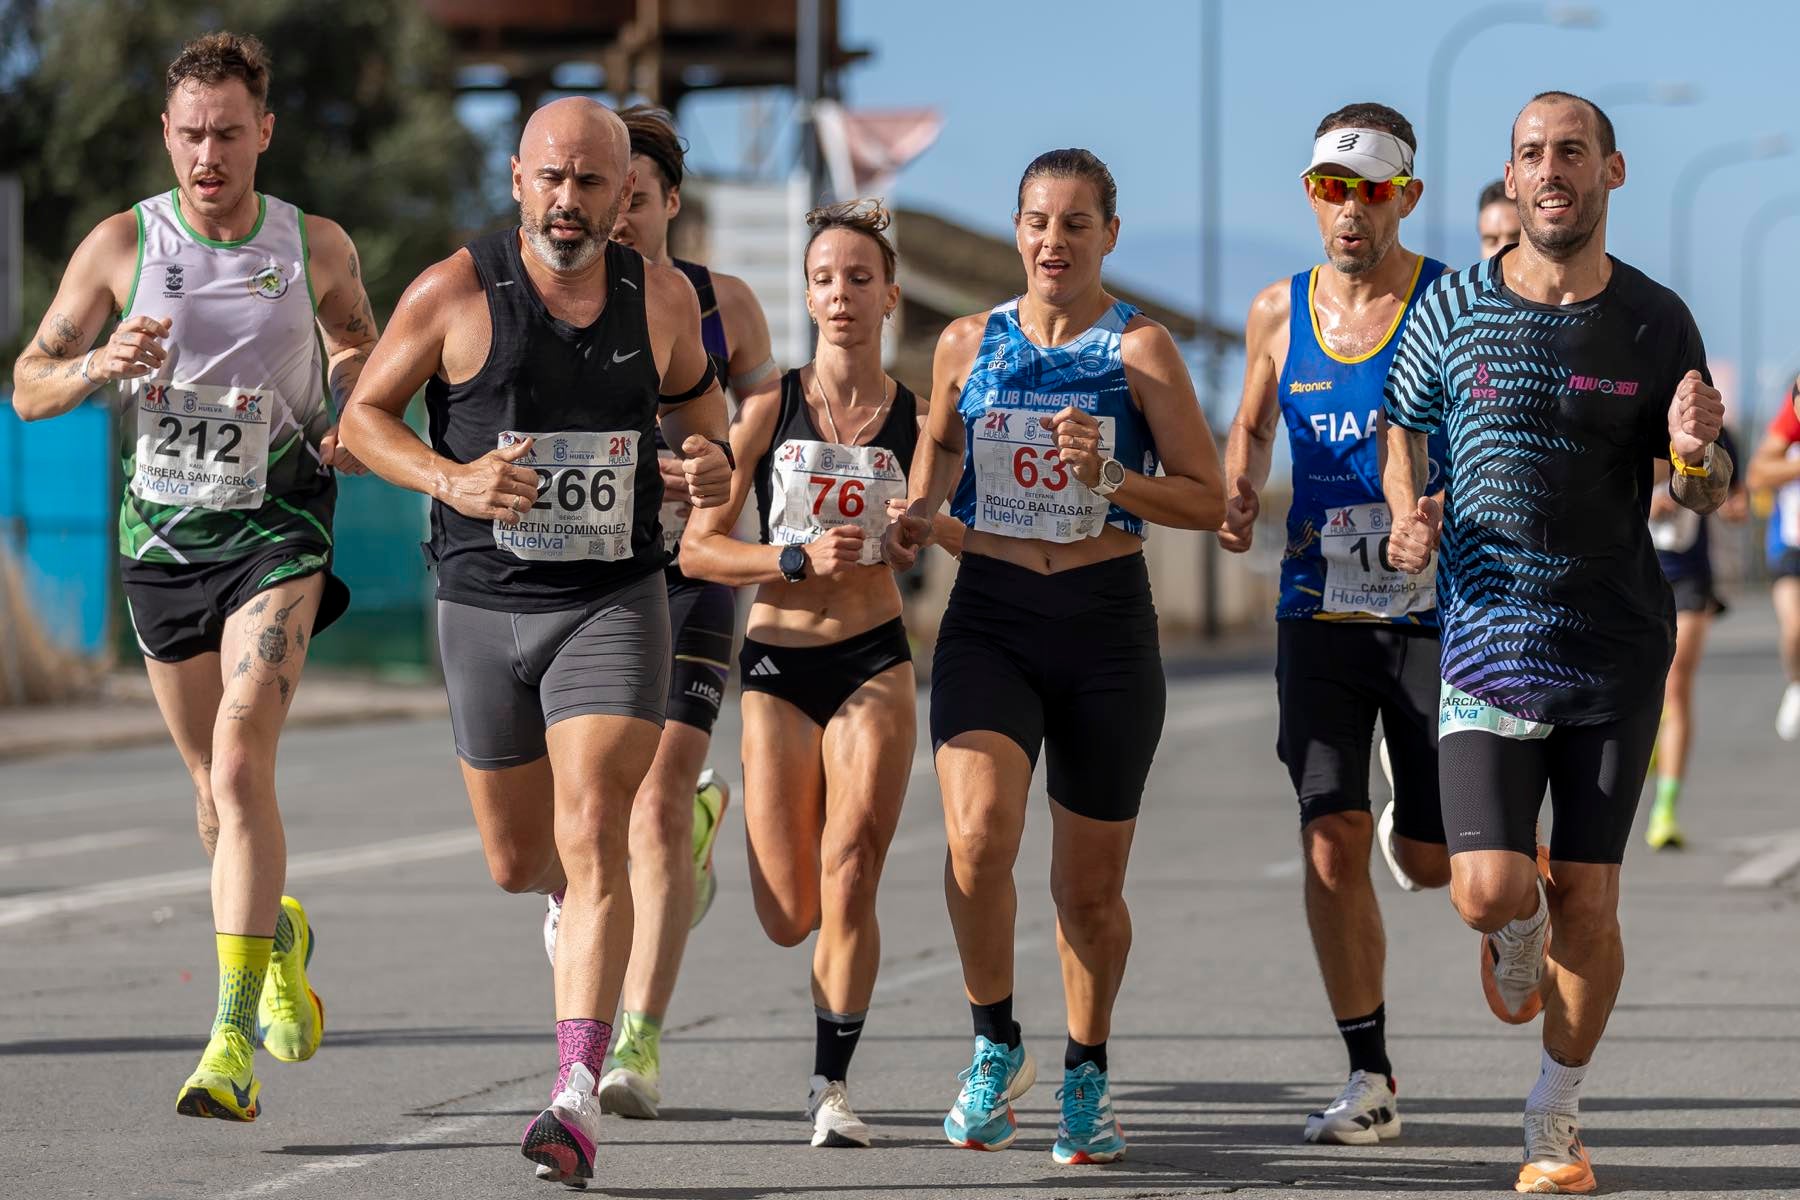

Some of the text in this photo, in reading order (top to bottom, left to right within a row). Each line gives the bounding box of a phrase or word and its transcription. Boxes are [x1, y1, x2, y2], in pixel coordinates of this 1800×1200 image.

[985, 390, 1098, 410] CLUB ONUBENSE
[1472, 389, 1497, 398] BY2
[985, 412, 1012, 433] 21K
[154, 416, 243, 464] 212
[984, 431, 1010, 440] HUELVA
[1013, 446, 1068, 492] 63
[531, 468, 617, 512] 266
[810, 476, 865, 518] 76
[983, 504, 1033, 527] Huelva
[986, 495, 1093, 516] ROUCO BALTASAR
[498, 522, 626, 535] MARTIN DOMINGUEZ
[501, 531, 563, 550] Huelva
[1361, 582, 1416, 593] CAMACHO
[1331, 589, 1389, 607] Huelva
